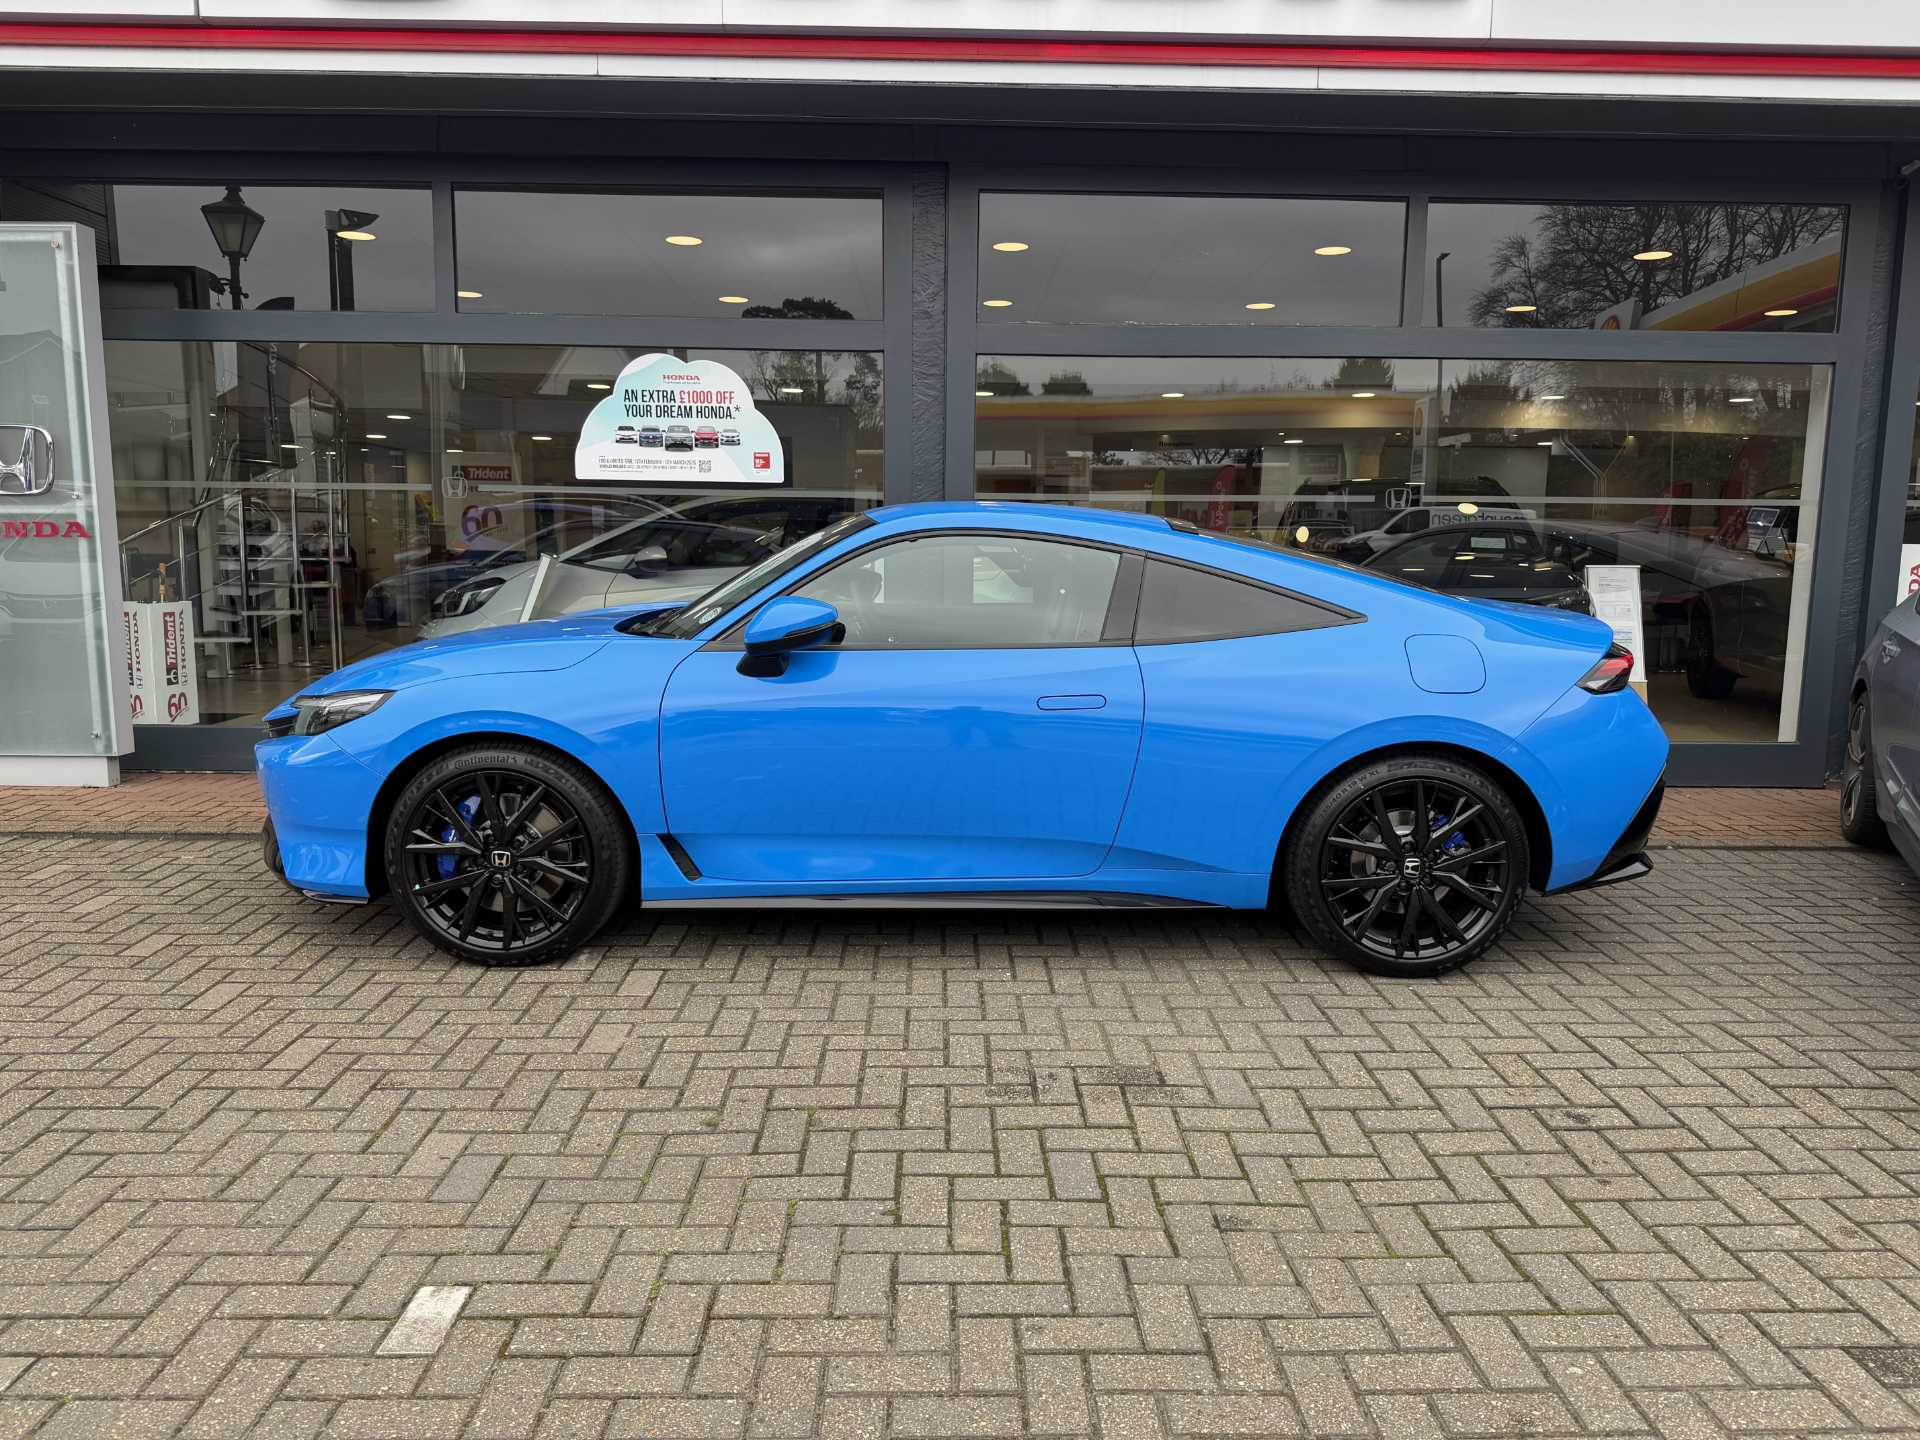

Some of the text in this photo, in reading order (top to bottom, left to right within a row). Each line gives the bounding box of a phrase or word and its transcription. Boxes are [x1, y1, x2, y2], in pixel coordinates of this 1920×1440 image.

[623, 389, 735, 405] AN EXTRA £1000 OFF
[624, 404, 652, 418] YOUR
[655, 405, 693, 419] DREAM
[468, 468, 510, 480] Trident
[133, 611, 142, 672] HONDA
[164, 614, 178, 667] Trident
[179, 608, 187, 671] HONDA
